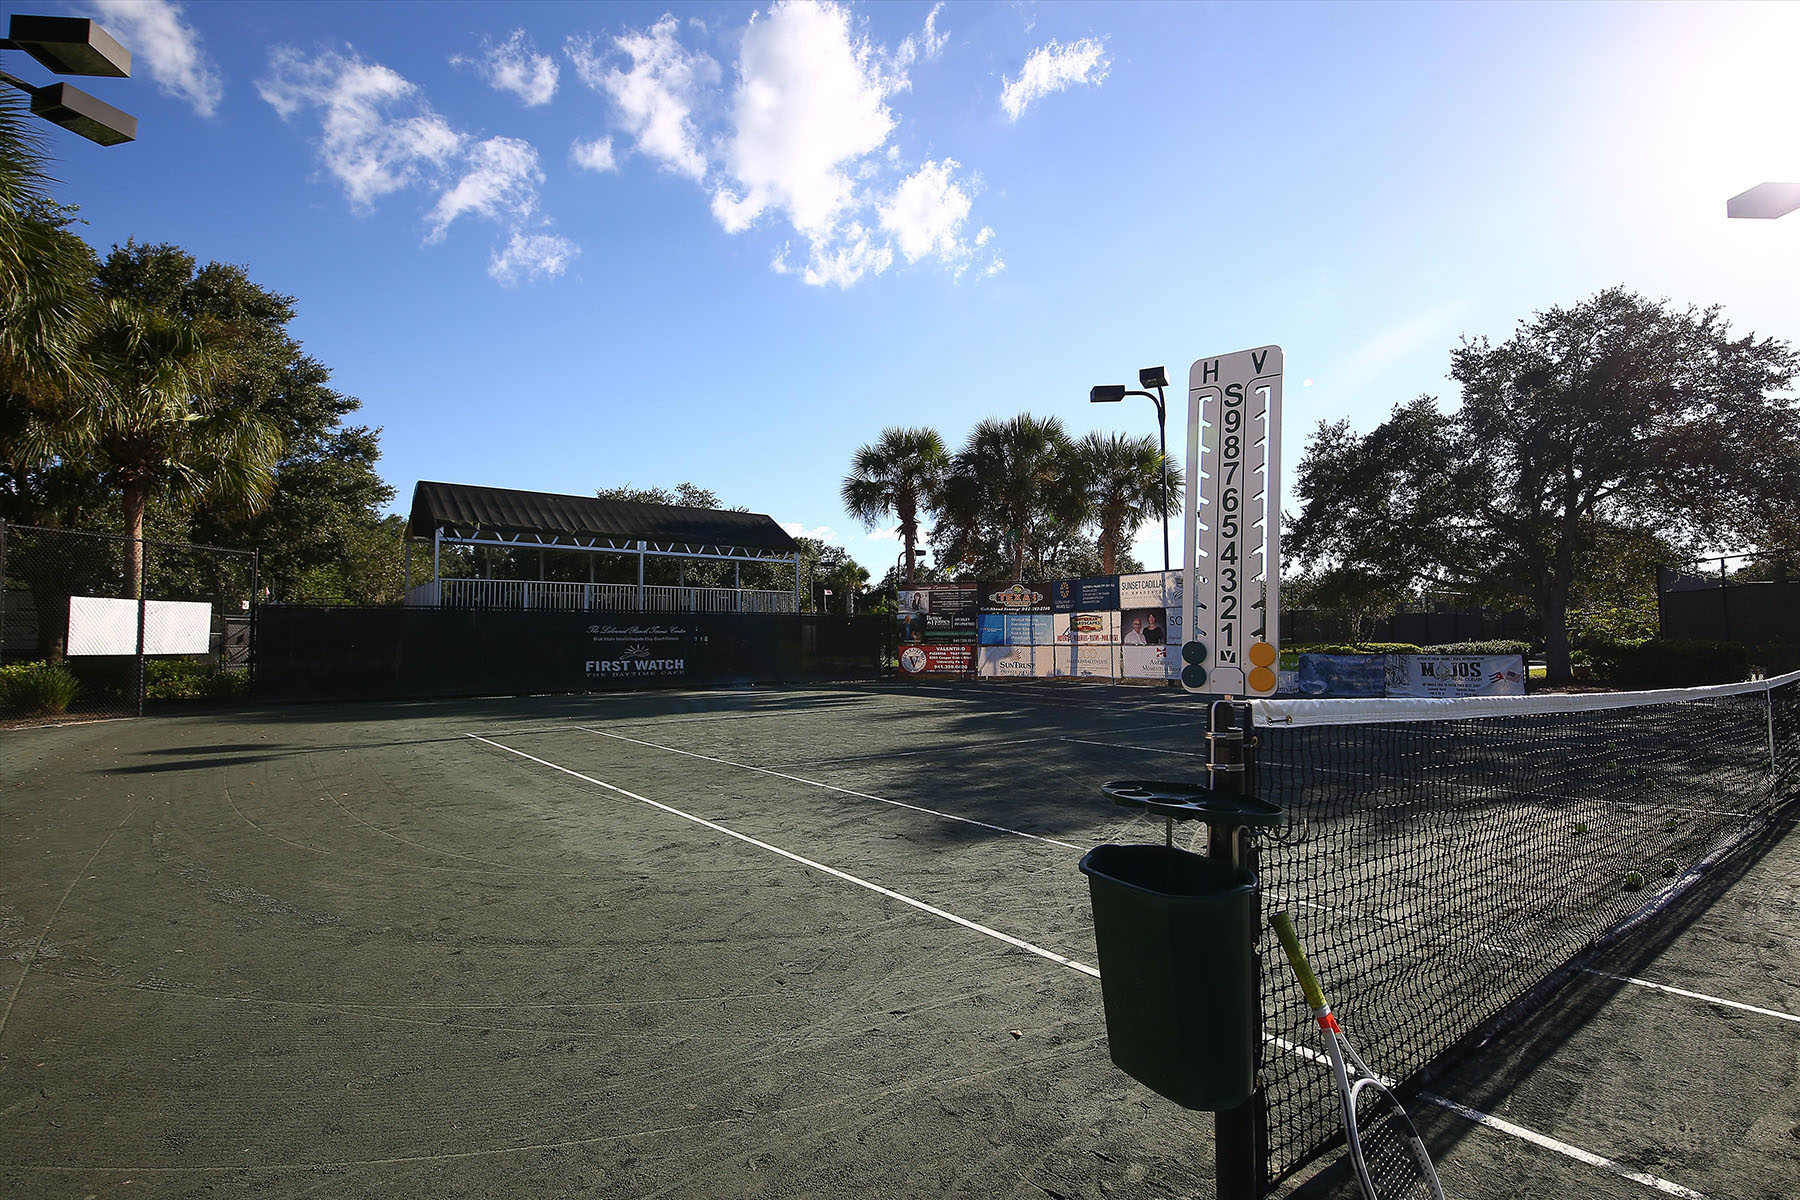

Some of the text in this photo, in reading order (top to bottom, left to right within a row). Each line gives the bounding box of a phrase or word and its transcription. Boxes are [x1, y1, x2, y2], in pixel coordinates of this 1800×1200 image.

[1203, 350, 1268, 384] H V
[1121, 581, 1141, 590] SUNSET
[1000, 593, 1038, 602] TEXAS
[585, 659, 684, 672] FIRST WATCH
